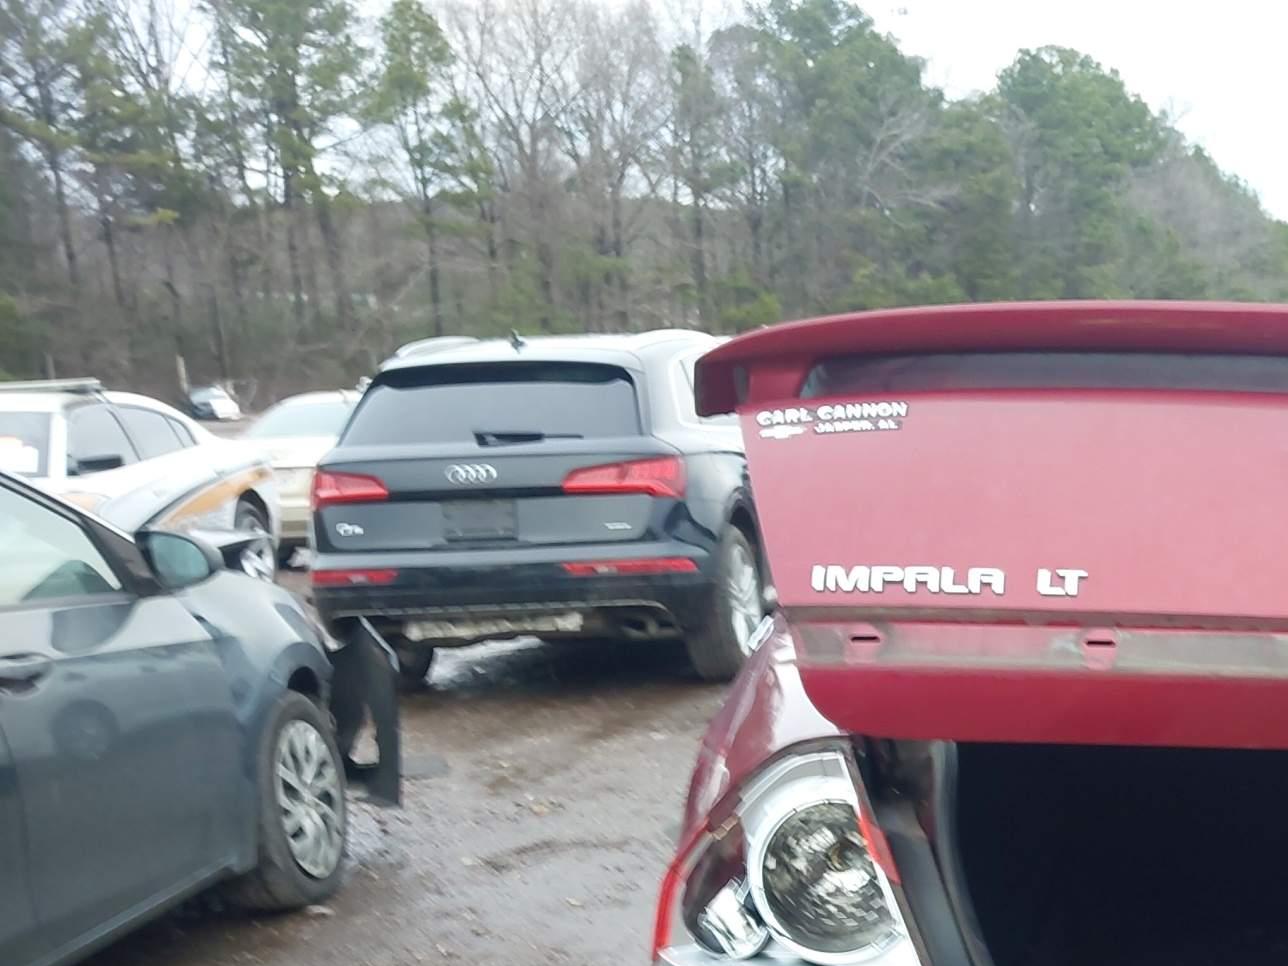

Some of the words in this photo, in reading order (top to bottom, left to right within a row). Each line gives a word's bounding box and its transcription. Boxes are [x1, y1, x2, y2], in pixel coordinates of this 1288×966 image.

[756, 408, 813, 426] CARL
[816, 402, 908, 420] CANNON
[811, 565, 1005, 594] IMPALA
[1036, 568, 1089, 596] LT
